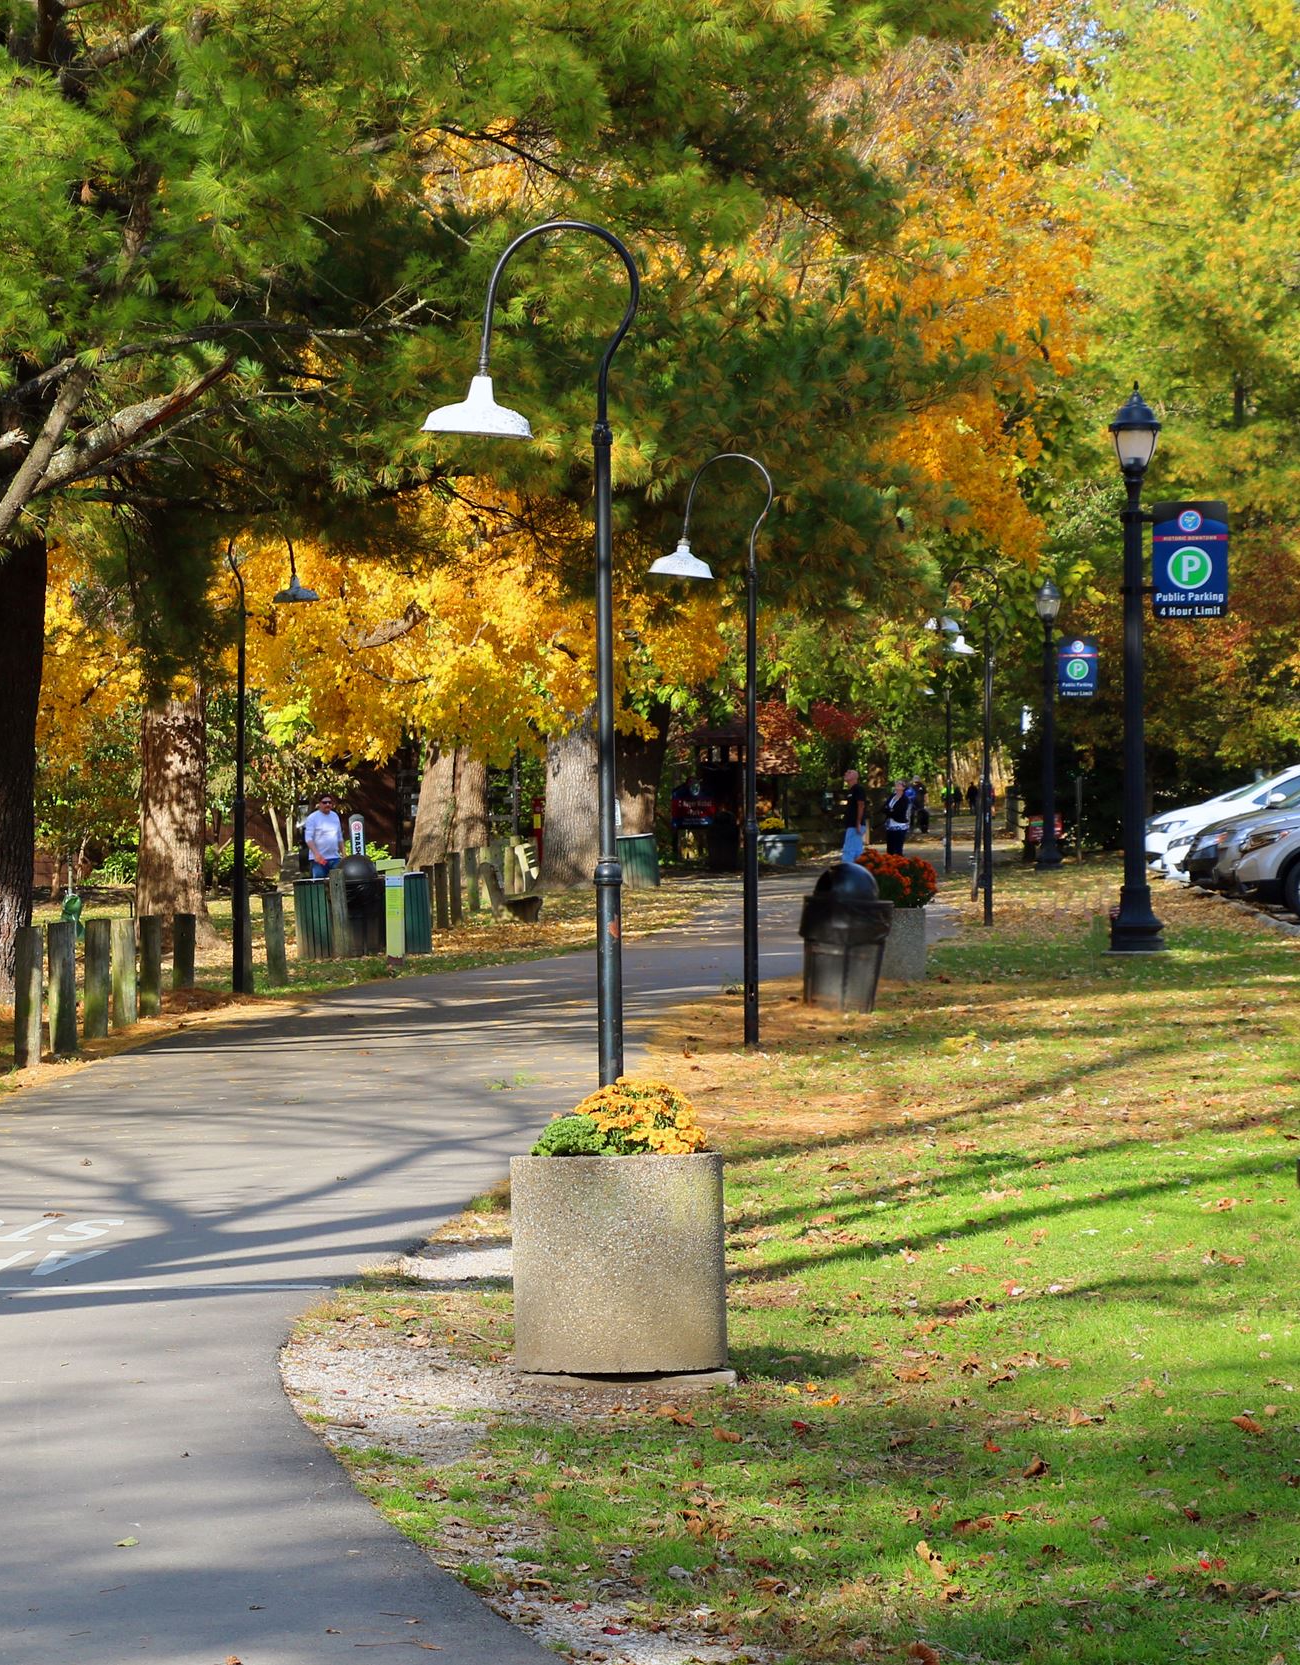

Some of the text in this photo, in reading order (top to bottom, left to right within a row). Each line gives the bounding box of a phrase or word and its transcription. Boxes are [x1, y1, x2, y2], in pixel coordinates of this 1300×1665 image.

[1181, 555, 1201, 582] P
[1156, 592, 1224, 603] Public Parking
[1160, 606, 1221, 616] 4 Hour Limit
